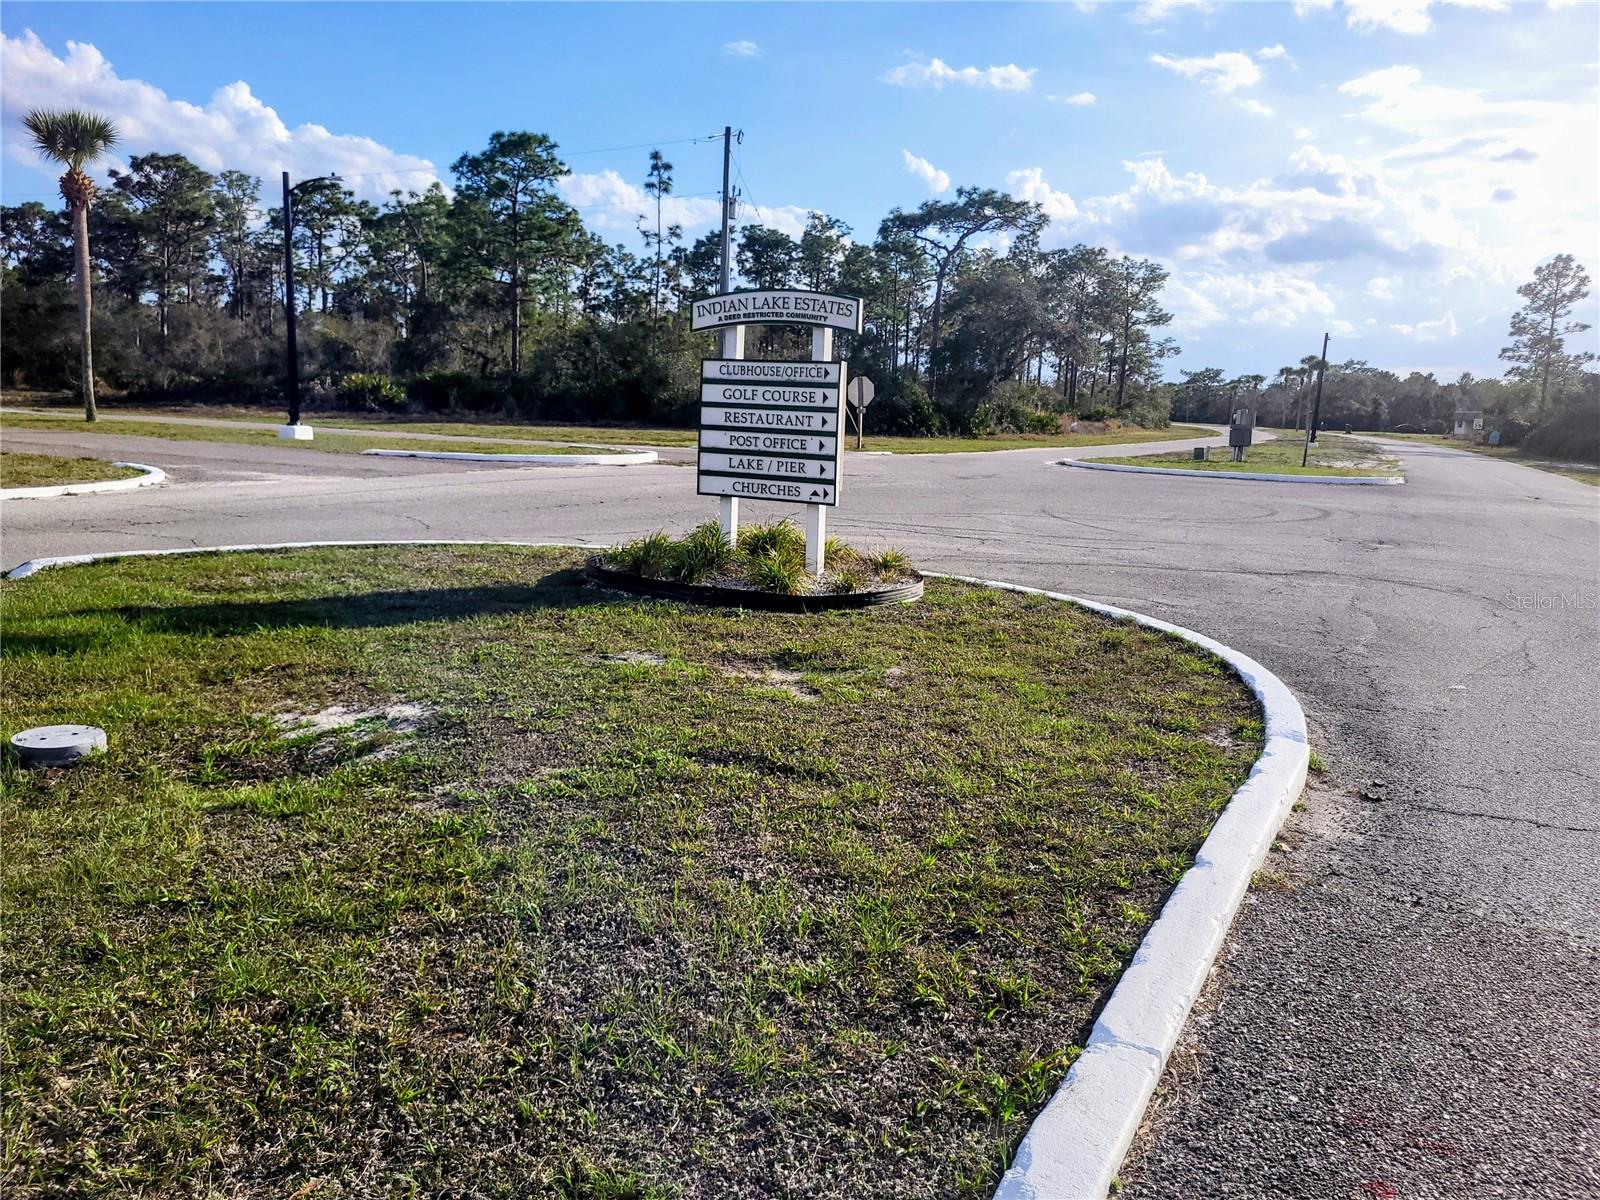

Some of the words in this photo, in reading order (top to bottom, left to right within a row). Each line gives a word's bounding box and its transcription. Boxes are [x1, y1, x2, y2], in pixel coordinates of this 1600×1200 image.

[697, 298, 749, 318] INDIAN
[752, 297, 790, 310] LAKE
[794, 298, 853, 317] ESTATES
[743, 311, 784, 319] RESTRICTED
[785, 312, 828, 322] COMMUNITY
[719, 364, 823, 378] CLUBHOUSE/OFFICE
[722, 388, 758, 401] GOLF
[762, 390, 816, 403] COURSE
[724, 412, 813, 427] RESTAURANT
[729, 435, 759, 447] POST
[763, 437, 807, 450] OFFICE
[728, 457, 763, 471] LAKE
[777, 461, 806, 474] PIER
[732, 481, 801, 497] CHURCHES
